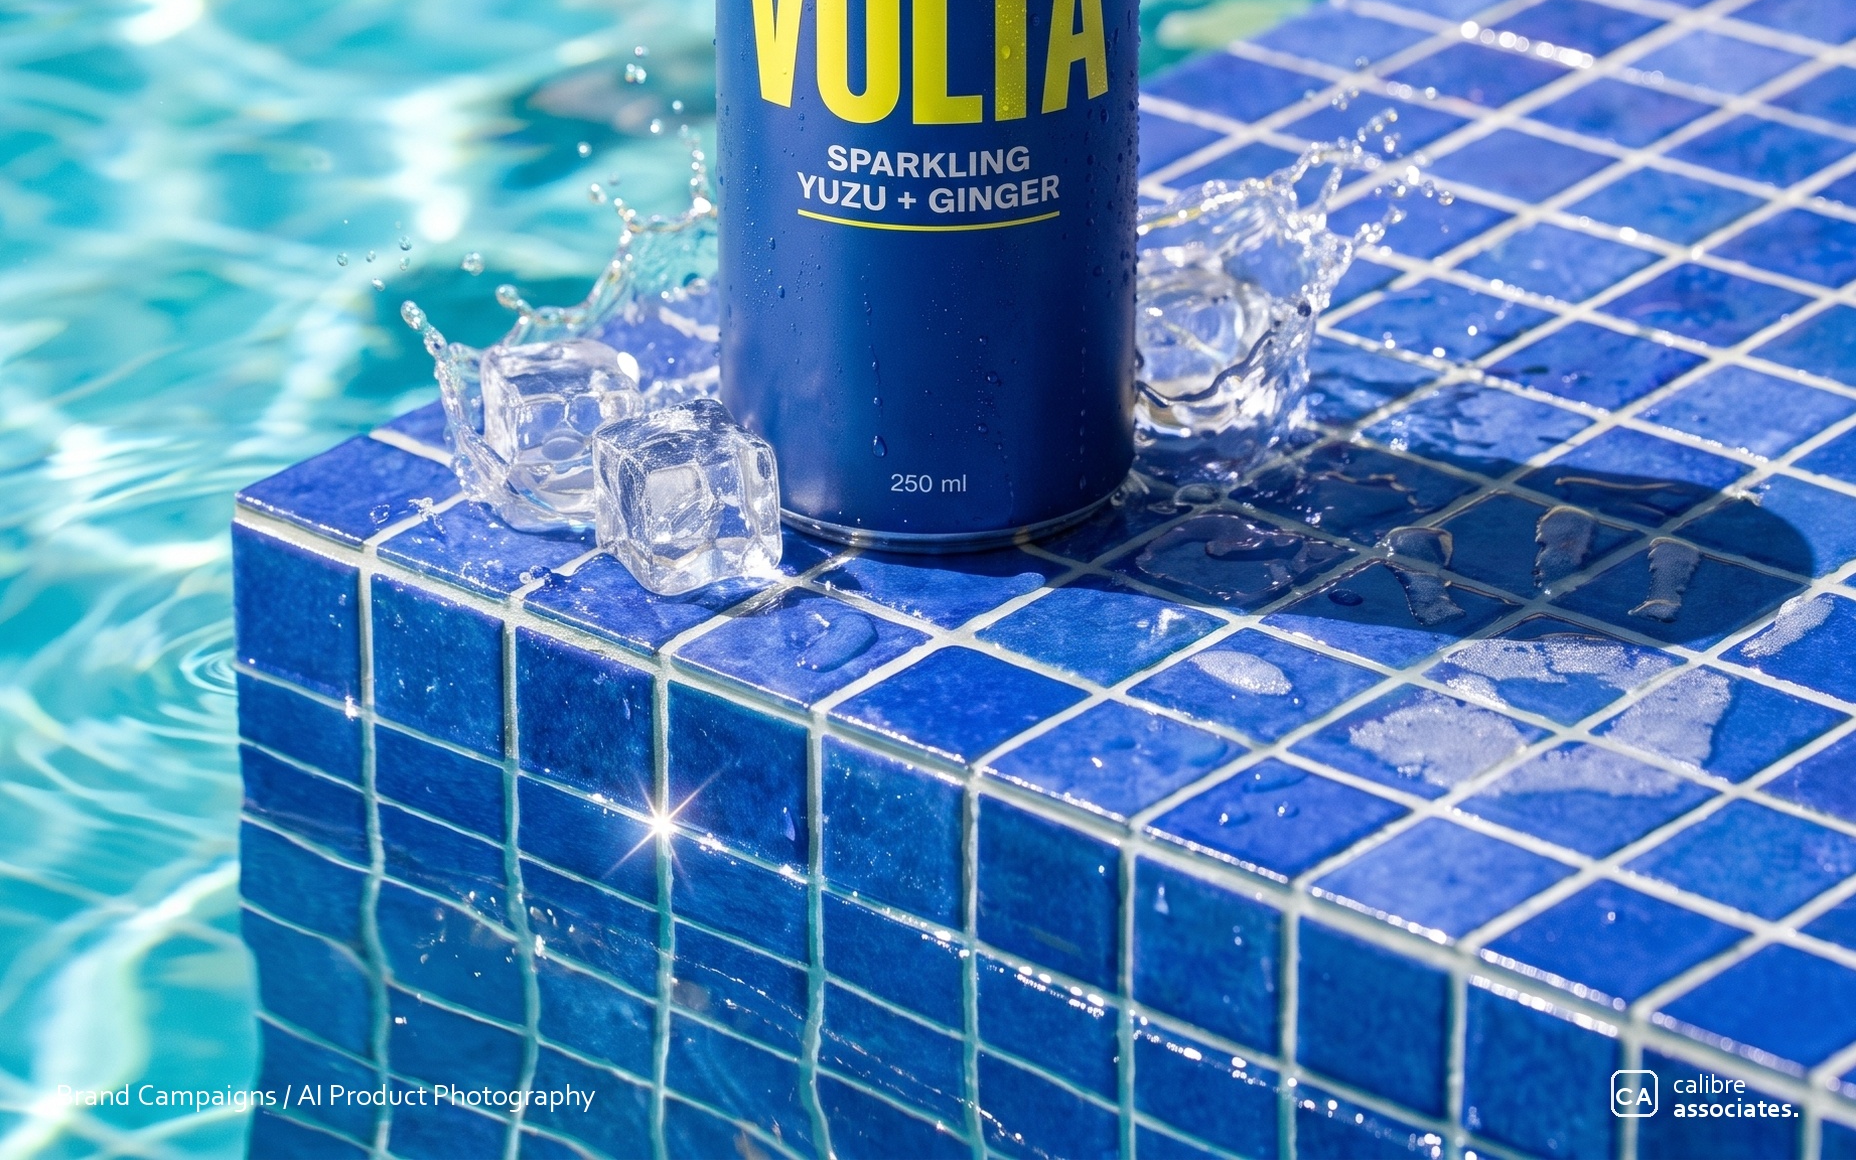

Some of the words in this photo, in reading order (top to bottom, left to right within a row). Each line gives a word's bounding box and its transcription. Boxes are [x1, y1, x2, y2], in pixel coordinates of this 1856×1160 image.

[827, 144, 1030, 178] SPARKLING
[797, 171, 886, 211] YUZU
[898, 191, 916, 210] +
[928, 174, 1060, 214] GINGER
[891, 473, 933, 493] 250
[941, 474, 967, 493] ml
